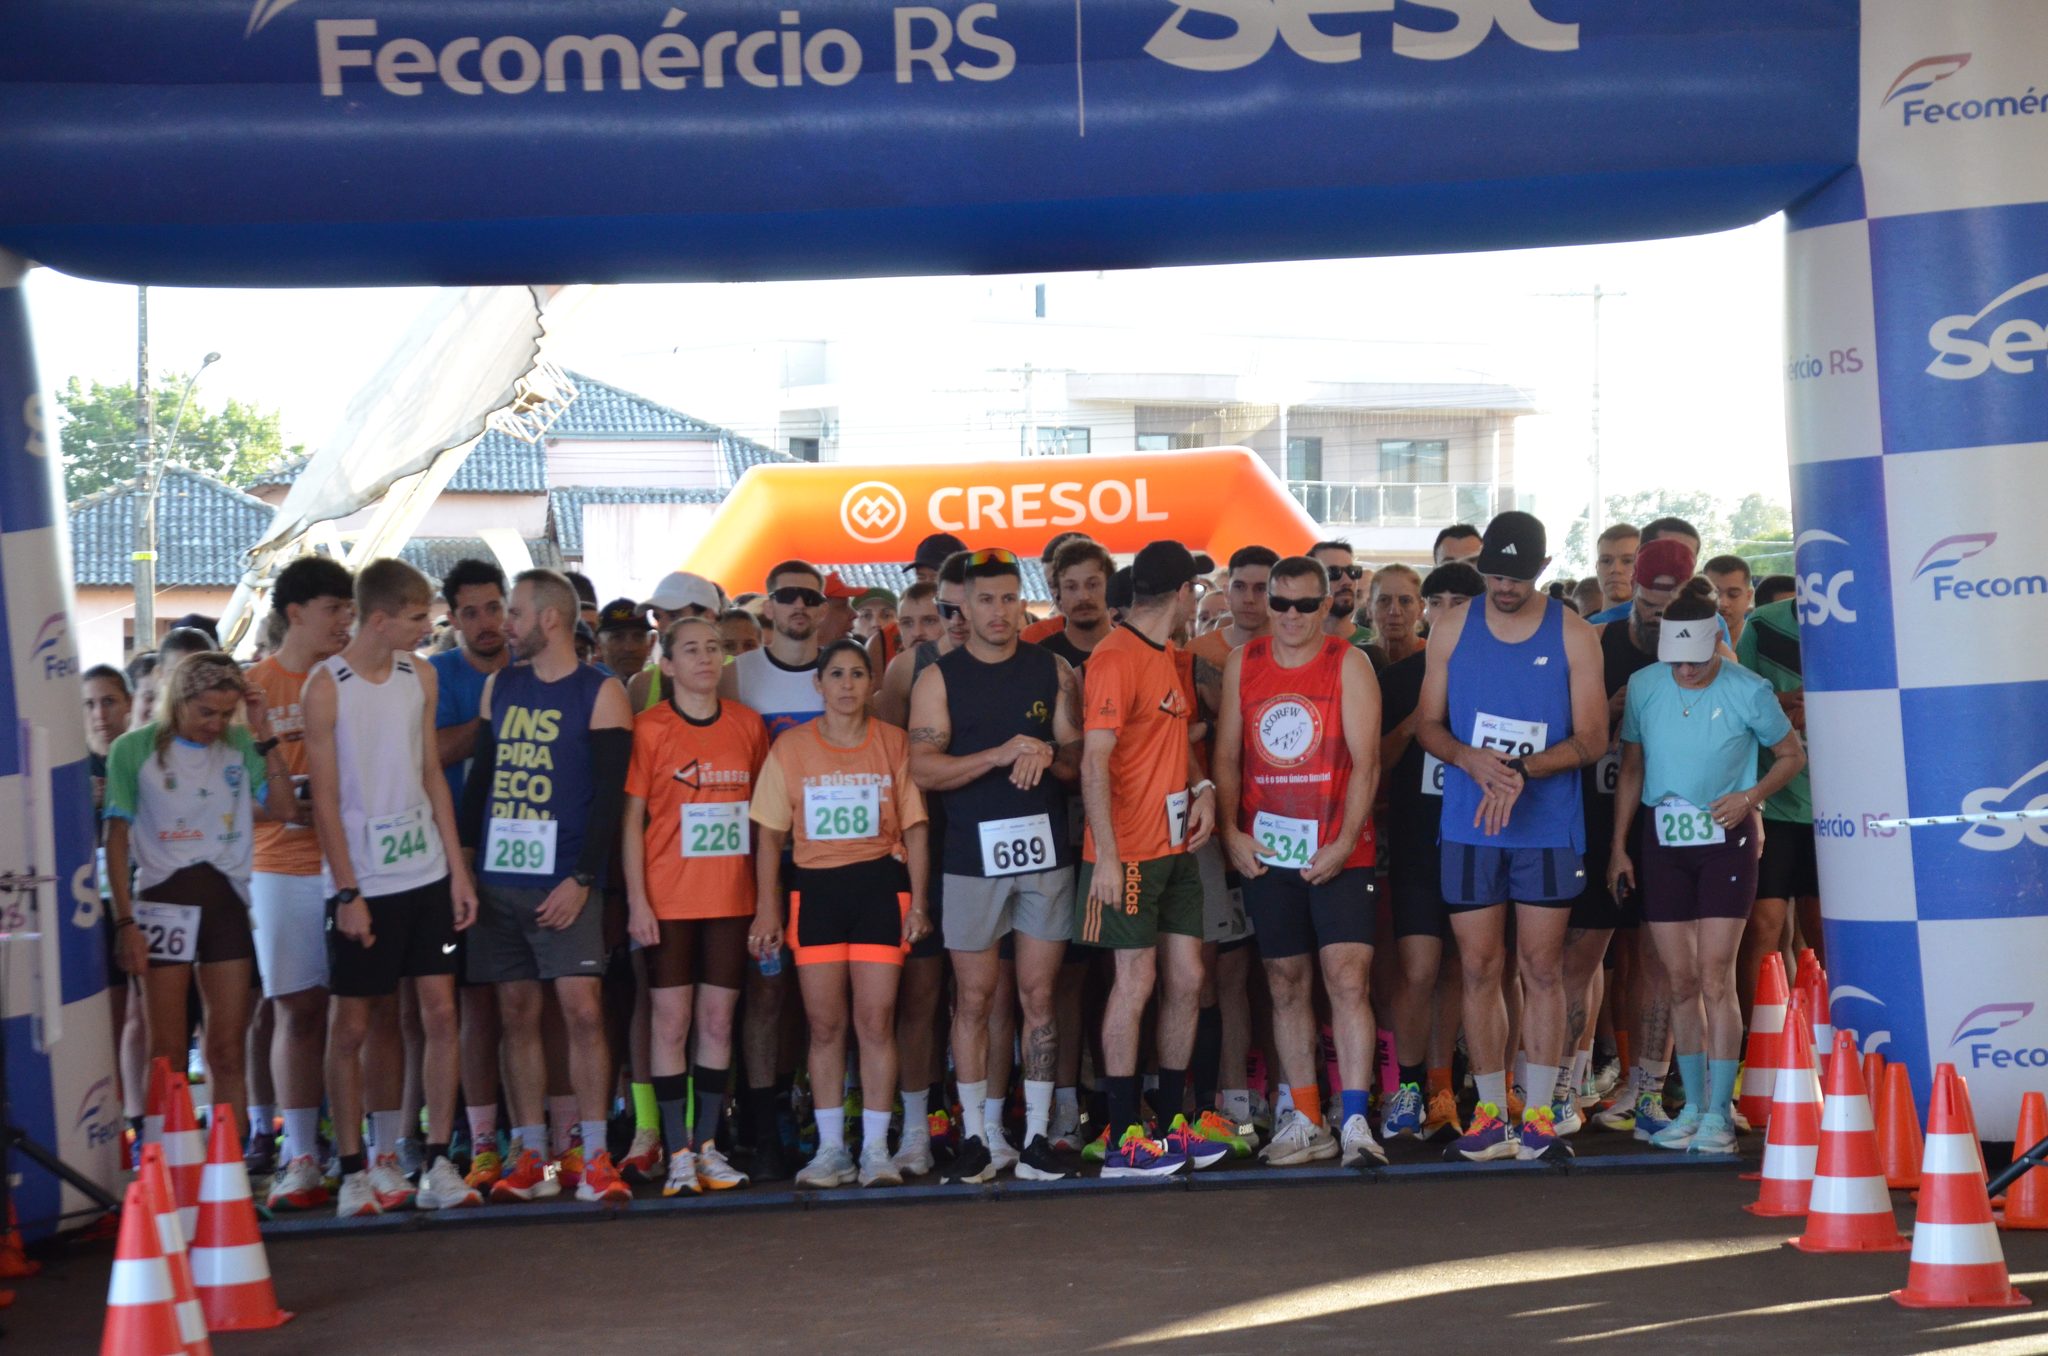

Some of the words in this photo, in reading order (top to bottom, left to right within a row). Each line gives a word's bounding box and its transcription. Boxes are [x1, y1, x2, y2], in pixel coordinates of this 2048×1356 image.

[315, 7, 863, 98] Fecomércio
[894, 3, 1017, 84] RS
[1829, 347, 1864, 375] RS
[928, 478, 1169, 532] CRESOL
[500, 705, 562, 742] INS
[496, 742, 554, 770] PIRA
[493, 770, 553, 803] ECO
[691, 822, 741, 852] 226
[815, 805, 869, 836] 268
[1662, 811, 1714, 842] 283
[380, 825, 427, 865] 244
[495, 838, 546, 870] 289
[993, 836, 1047, 870] 689
[1260, 831, 1309, 866] 334
[139, 922, 186, 957] 26
